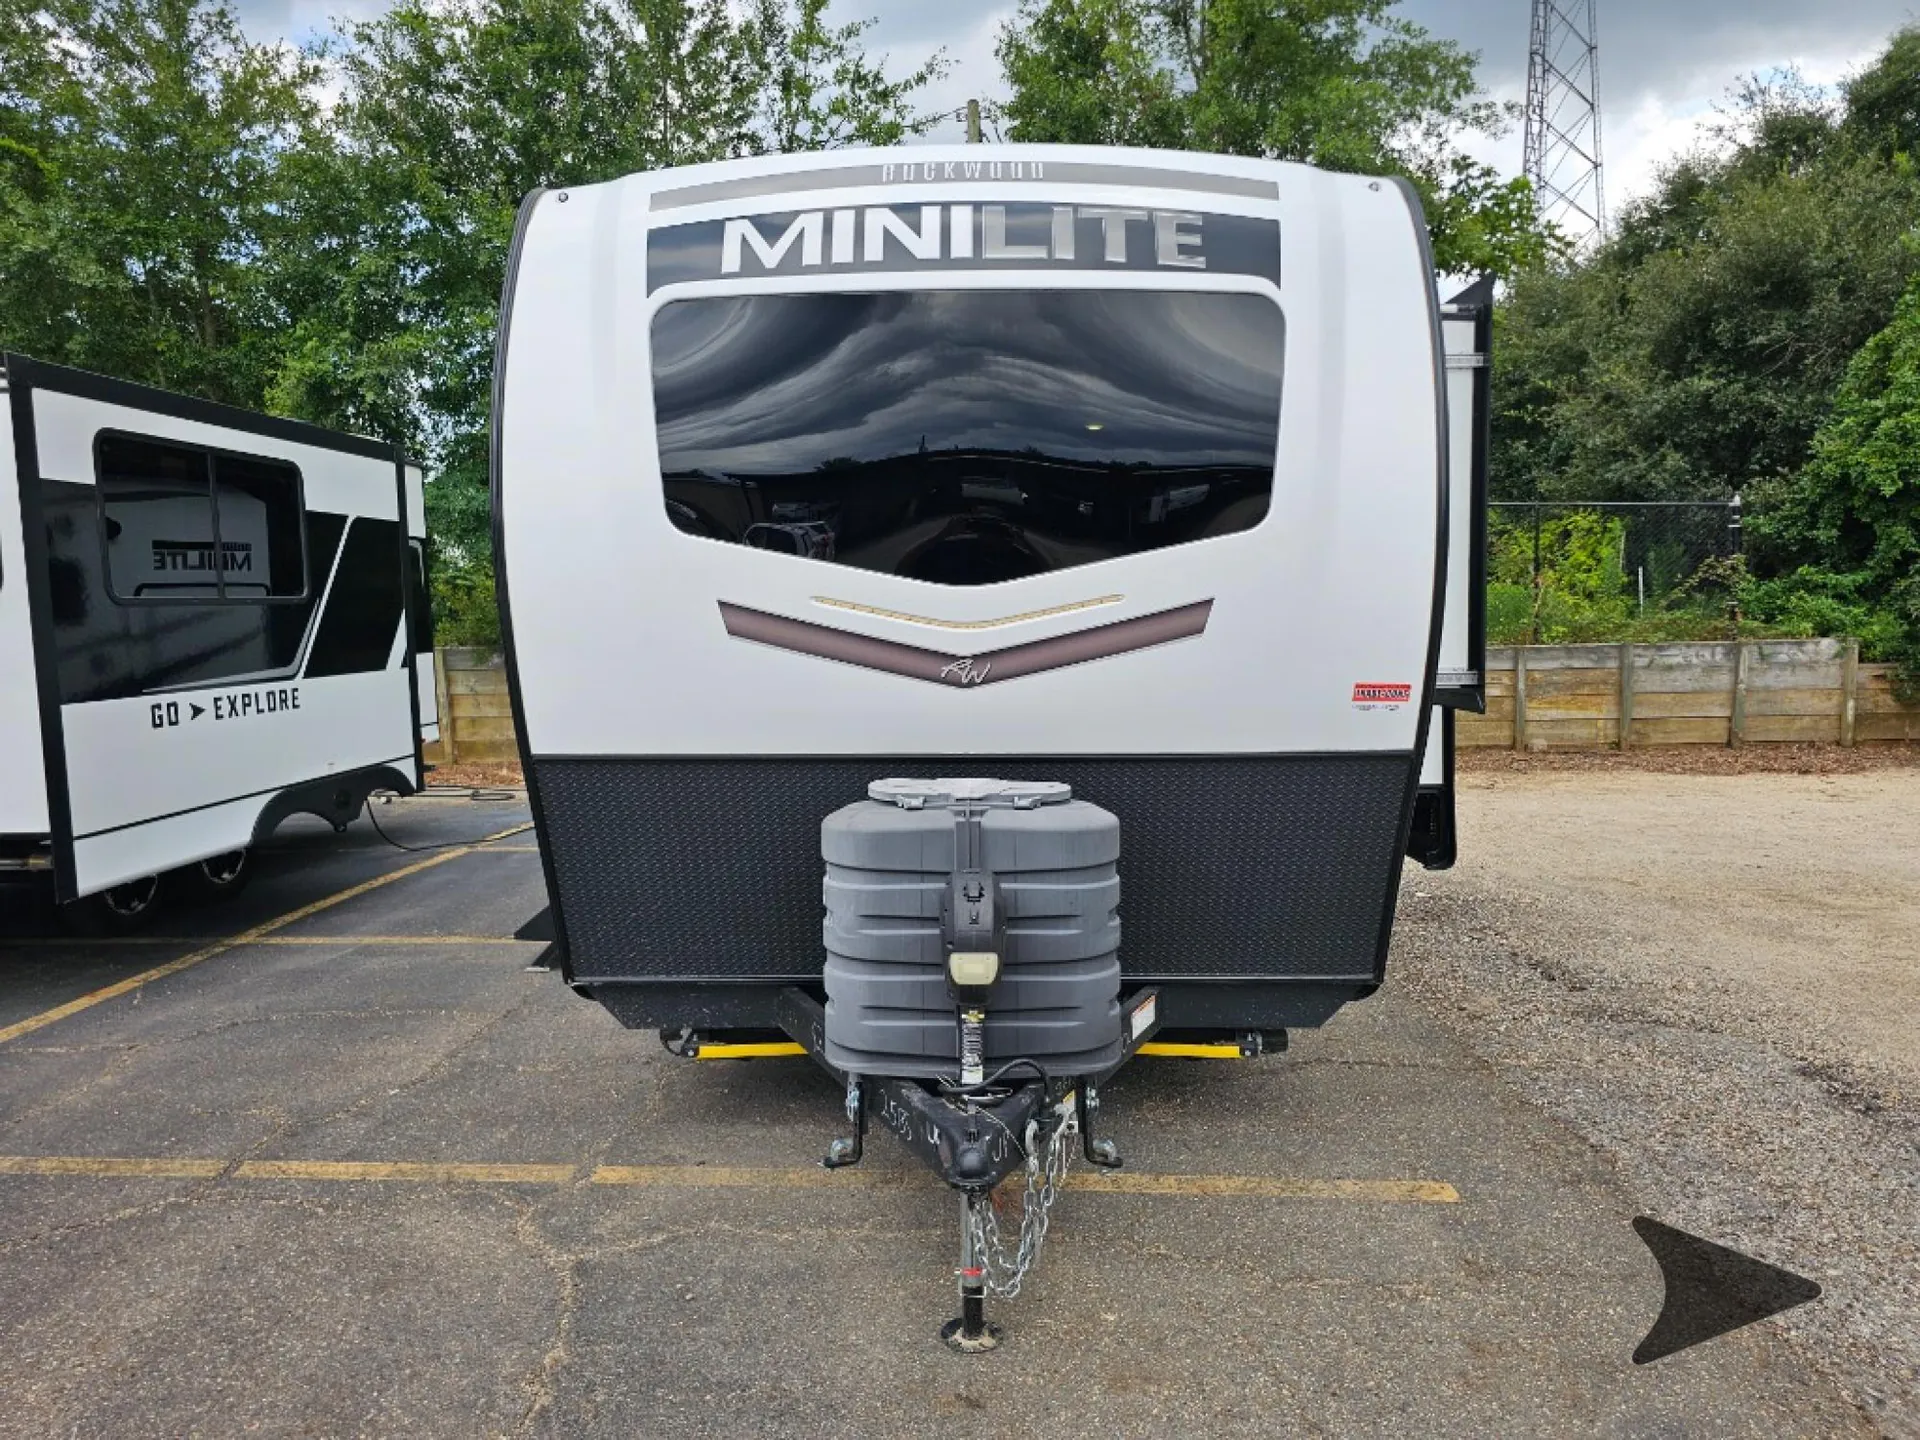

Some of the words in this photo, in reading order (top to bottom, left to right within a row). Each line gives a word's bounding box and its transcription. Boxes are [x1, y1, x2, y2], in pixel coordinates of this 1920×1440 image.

[721, 204, 1207, 274] MINILITE
[151, 701, 180, 729] GO
[213, 688, 301, 721] EXPLORE
